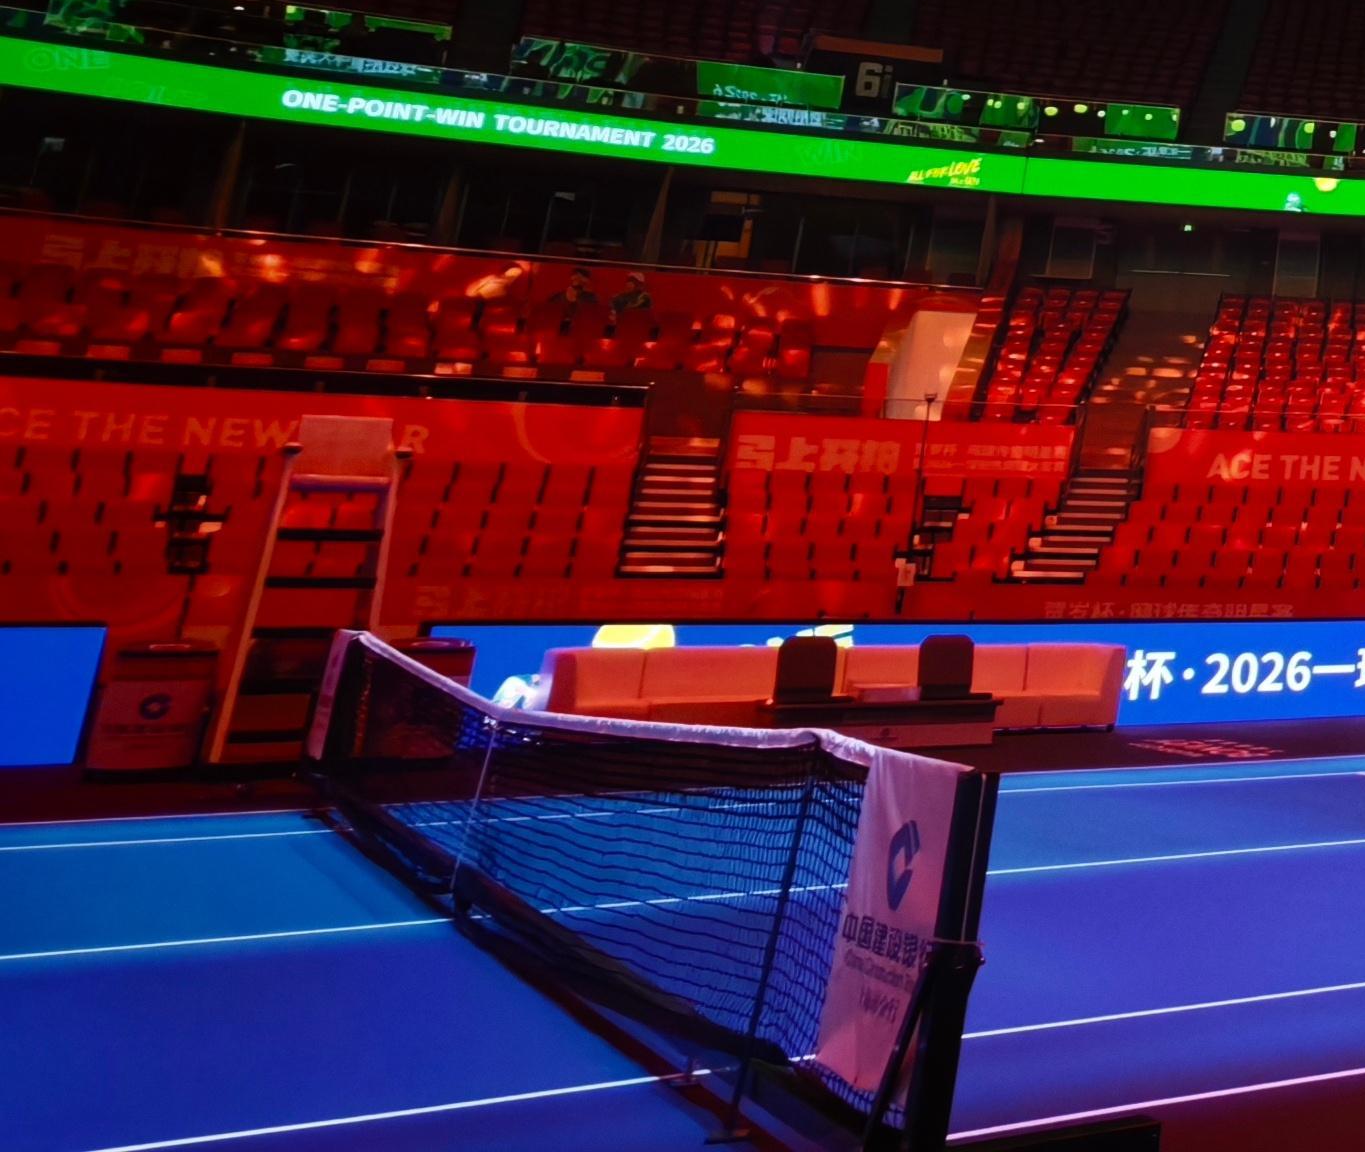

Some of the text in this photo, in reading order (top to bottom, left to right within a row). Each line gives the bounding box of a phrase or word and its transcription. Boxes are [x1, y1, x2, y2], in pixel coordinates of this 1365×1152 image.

[281, 88, 716, 155] ONE-POINT-WIN TOURNAMENT 2026
[75, 410, 169, 445] THE
[184, 416, 300, 449] NEW
[1206, 454, 1269, 481] ACE
[1282, 455, 1339, 481] THE
